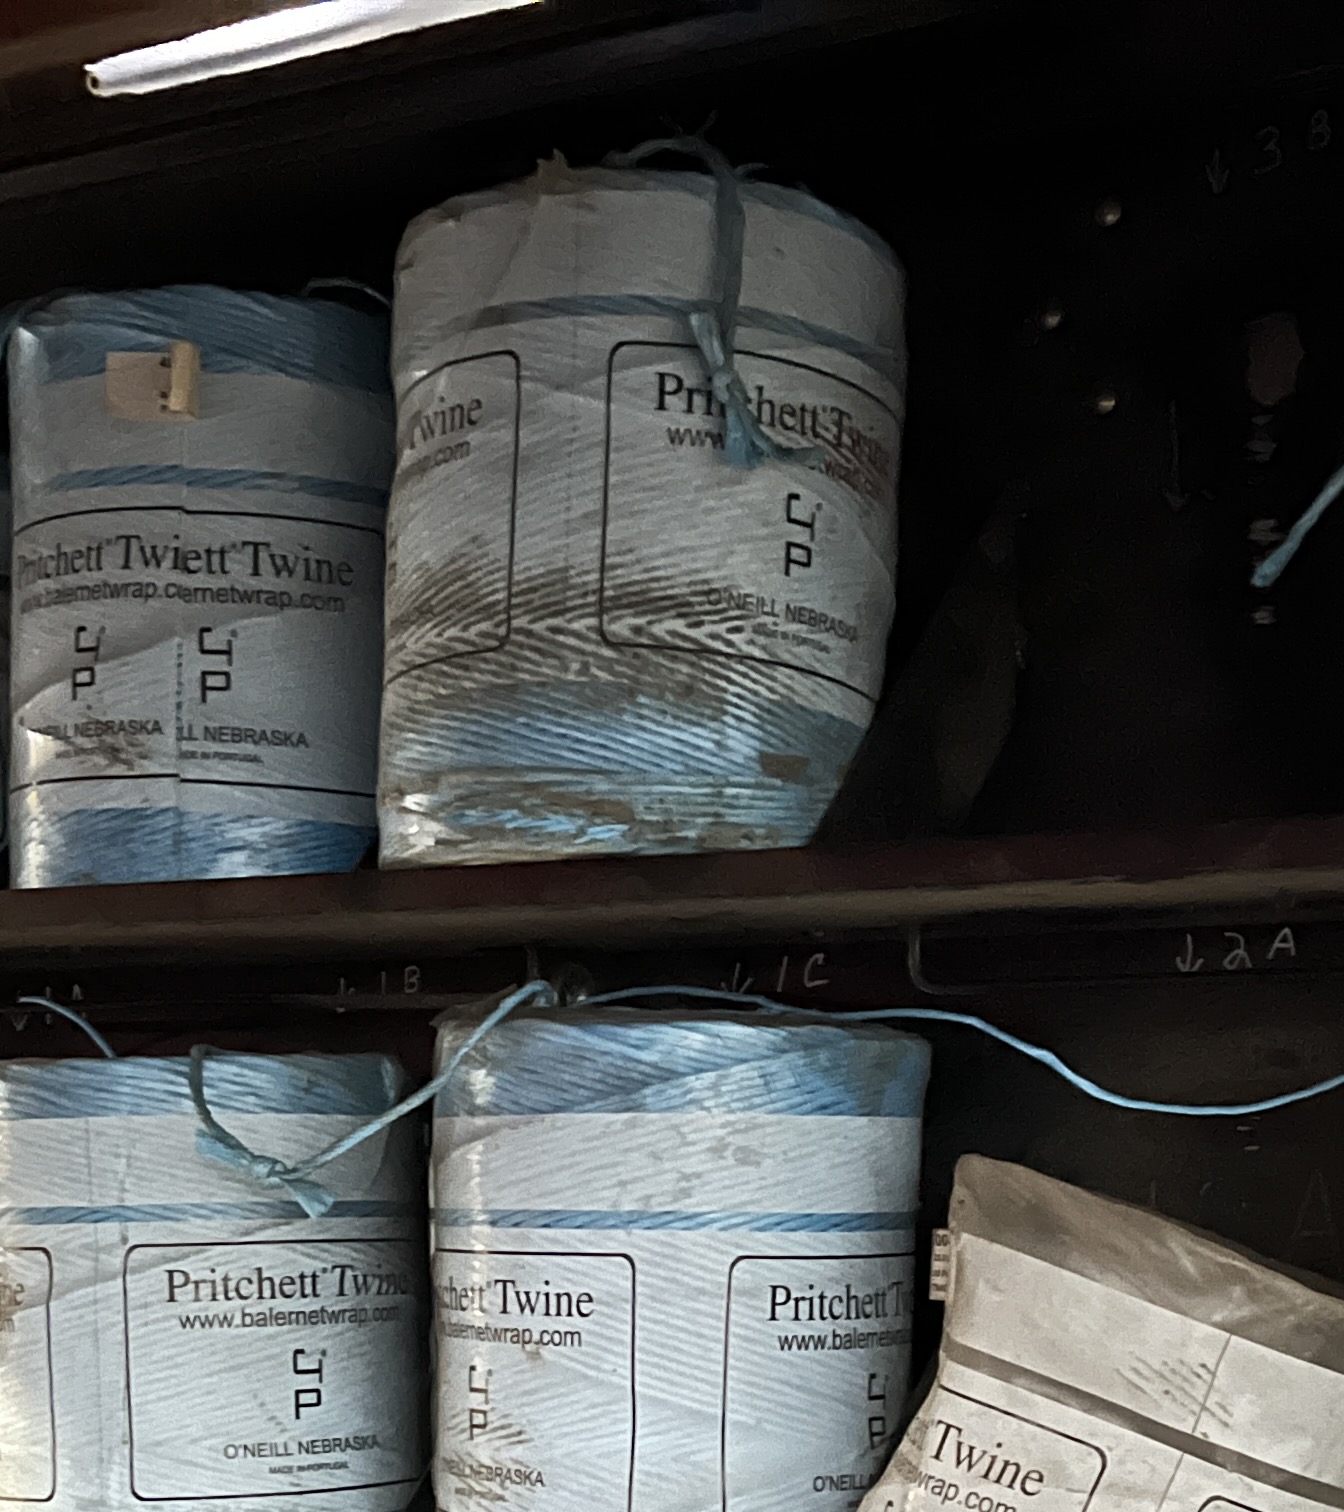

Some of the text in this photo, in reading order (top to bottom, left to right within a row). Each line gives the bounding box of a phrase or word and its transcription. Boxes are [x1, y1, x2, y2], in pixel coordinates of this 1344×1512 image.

[242, 541, 355, 586] Twine
[203, 726, 312, 749] NEBRASKA
[166, 1263, 408, 1303] Pritchett Twine
[494, 1279, 596, 1317] Twine
[767, 1283, 888, 1322] Pritchett
[223, 1434, 380, 1460] O'NEILL NEBRASKA
[930, 1420, 1045, 1497] Twine
